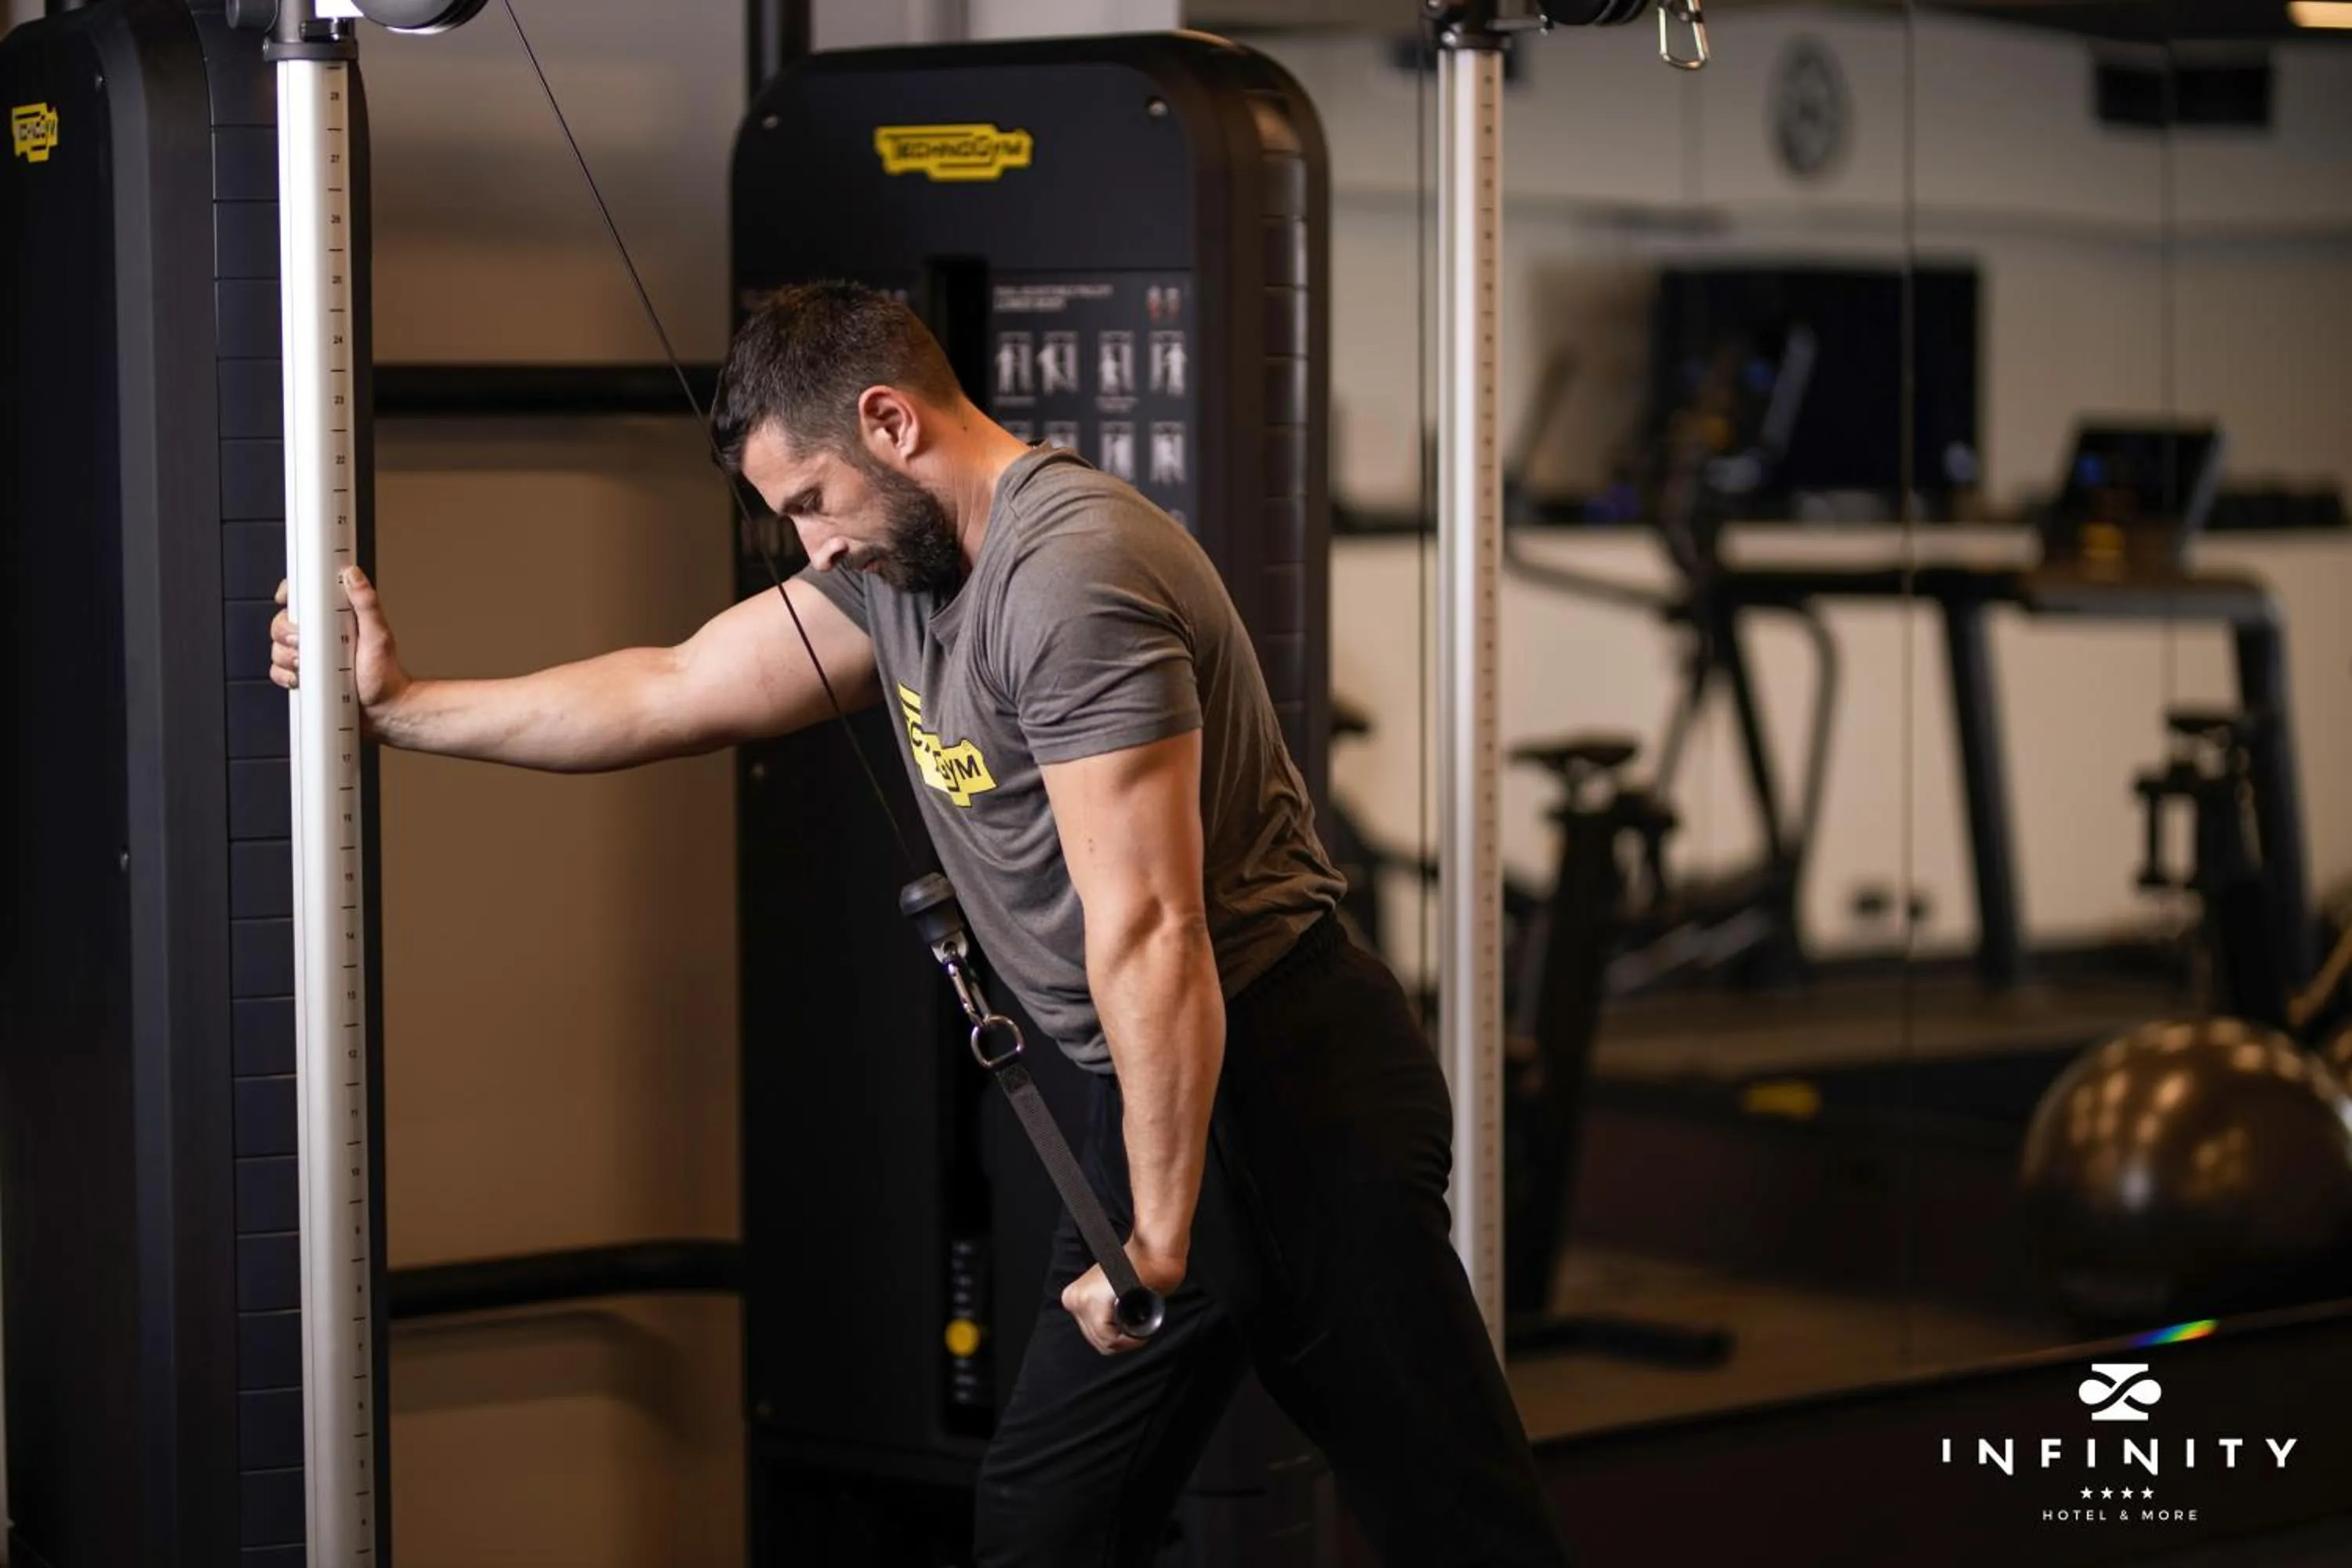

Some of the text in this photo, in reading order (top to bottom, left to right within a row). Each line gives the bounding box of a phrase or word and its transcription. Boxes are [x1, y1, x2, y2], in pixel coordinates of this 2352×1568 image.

[331, 154, 339, 163] 27
[333, 336, 343, 344] 24
[334, 395, 344, 405] 23
[336, 455, 345, 464] 22
[338, 516, 347, 524] 21
